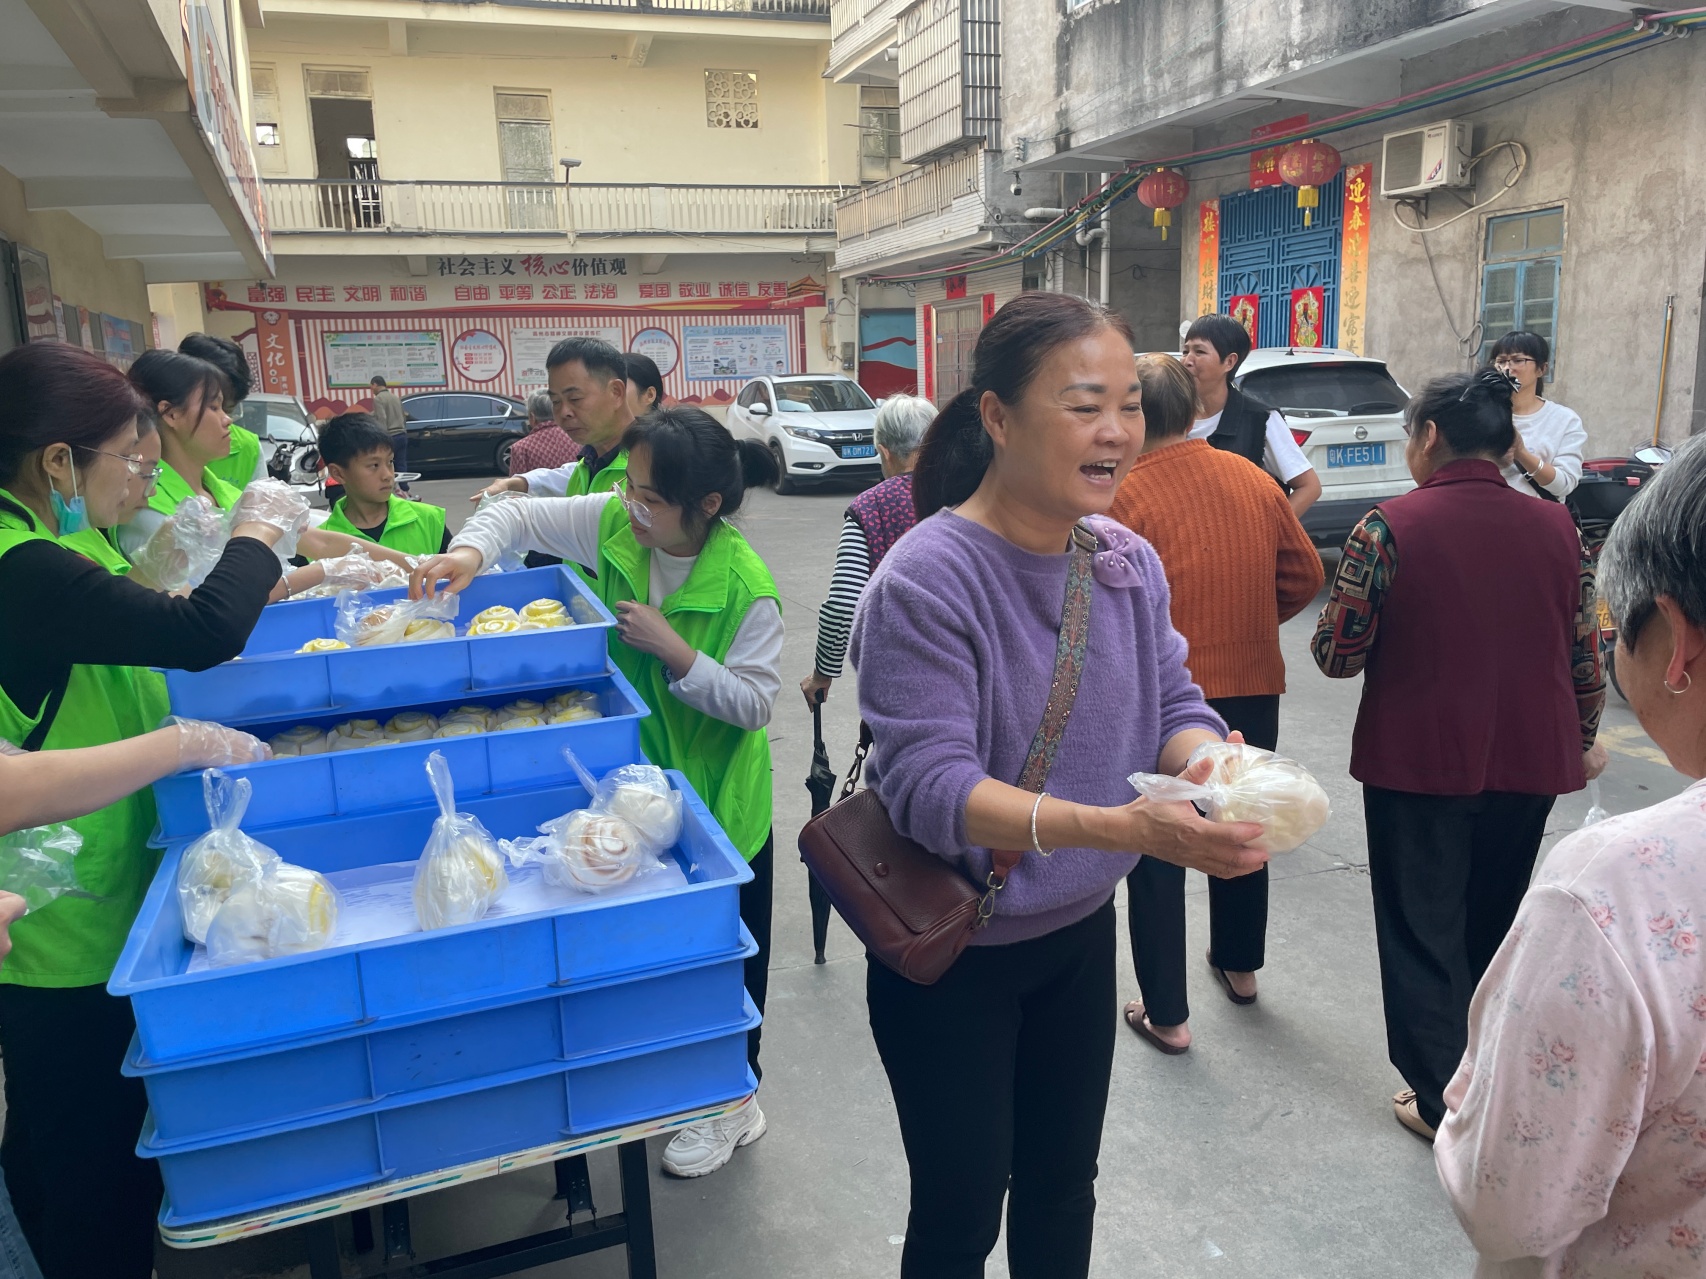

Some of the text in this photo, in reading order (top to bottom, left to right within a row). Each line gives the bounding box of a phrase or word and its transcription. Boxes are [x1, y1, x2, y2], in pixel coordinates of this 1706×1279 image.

[437, 254, 627, 277] 社会主义核心价值观
[247, 281, 788, 303] 富强 民主 文明 和谐 自由 平等 公正 法治 爱国 敬业 诚信 友善
[264, 333, 285, 367] 文化
